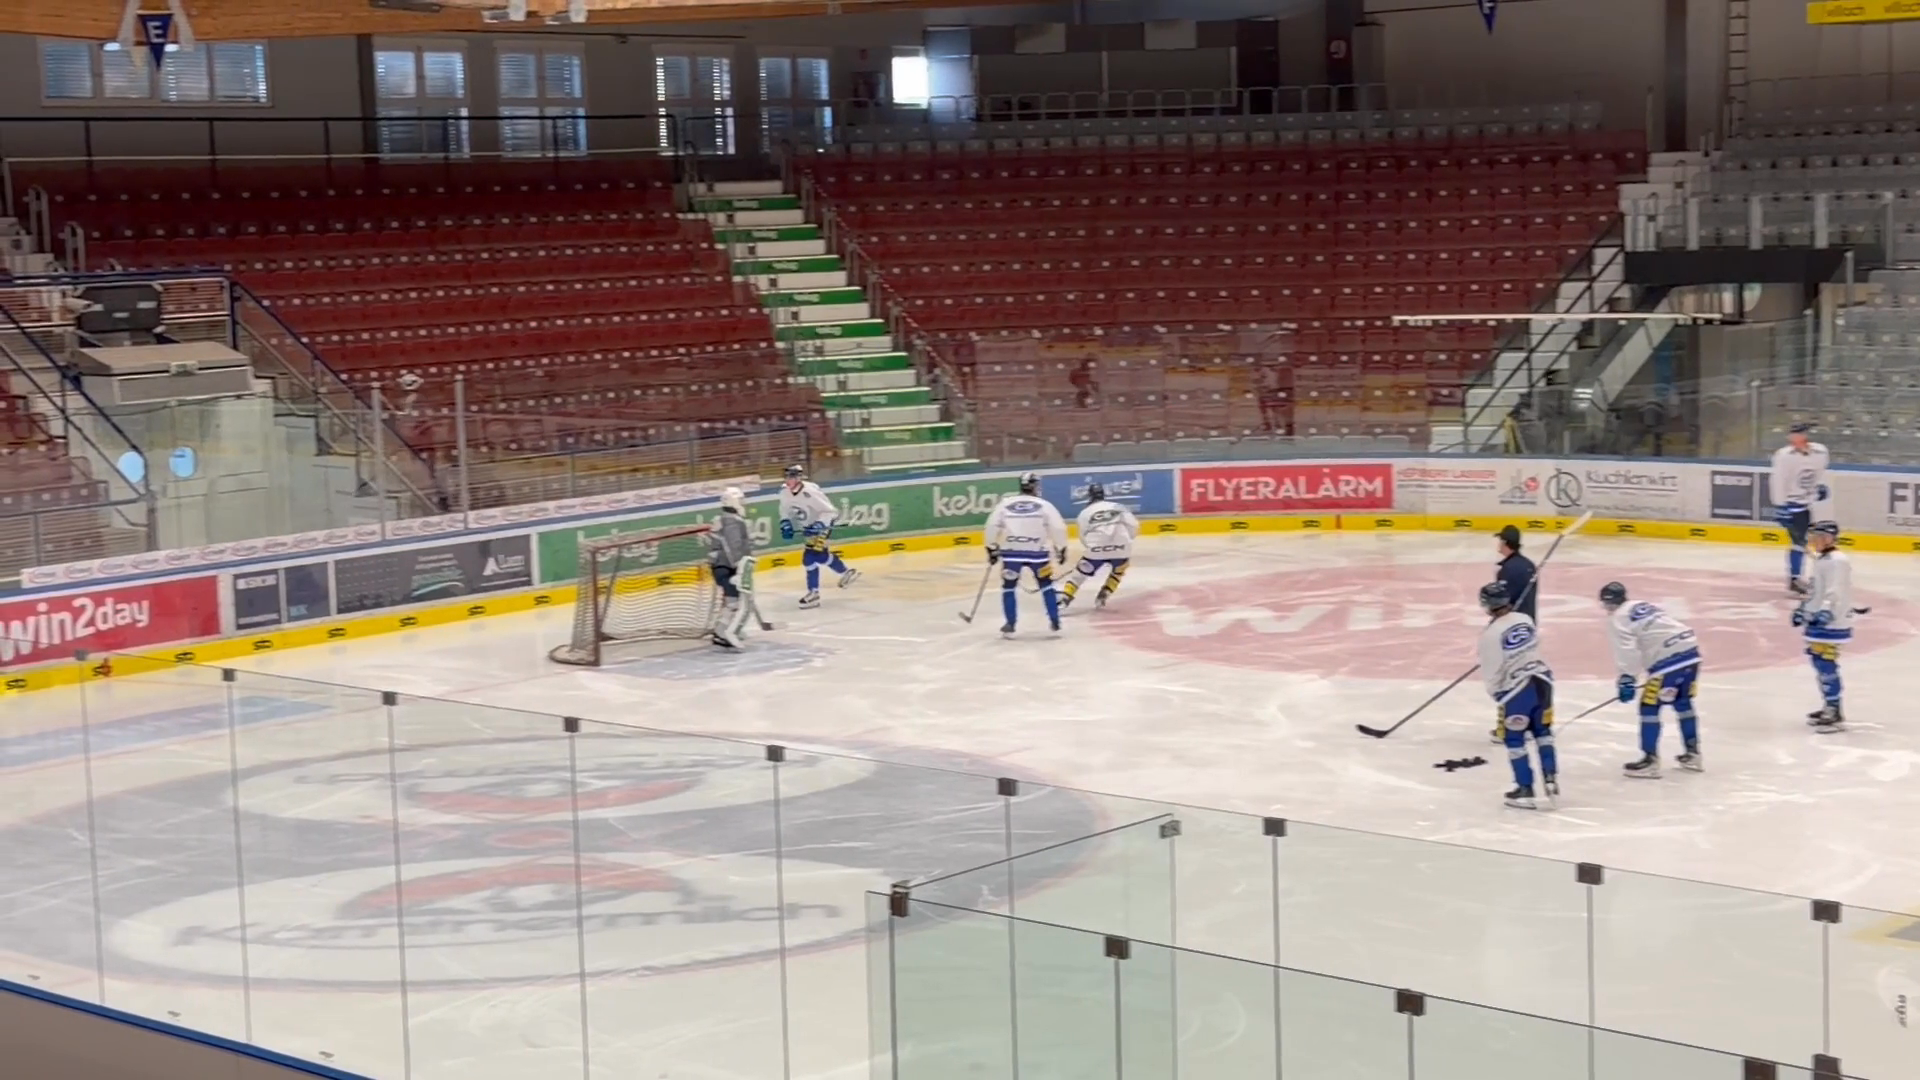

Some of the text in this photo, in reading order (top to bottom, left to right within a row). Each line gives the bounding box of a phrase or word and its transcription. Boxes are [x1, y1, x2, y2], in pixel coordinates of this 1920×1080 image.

[146, 21, 166, 43] E
[1090, 544, 1126, 553] CCM
[0, 597, 150, 661] win2day
